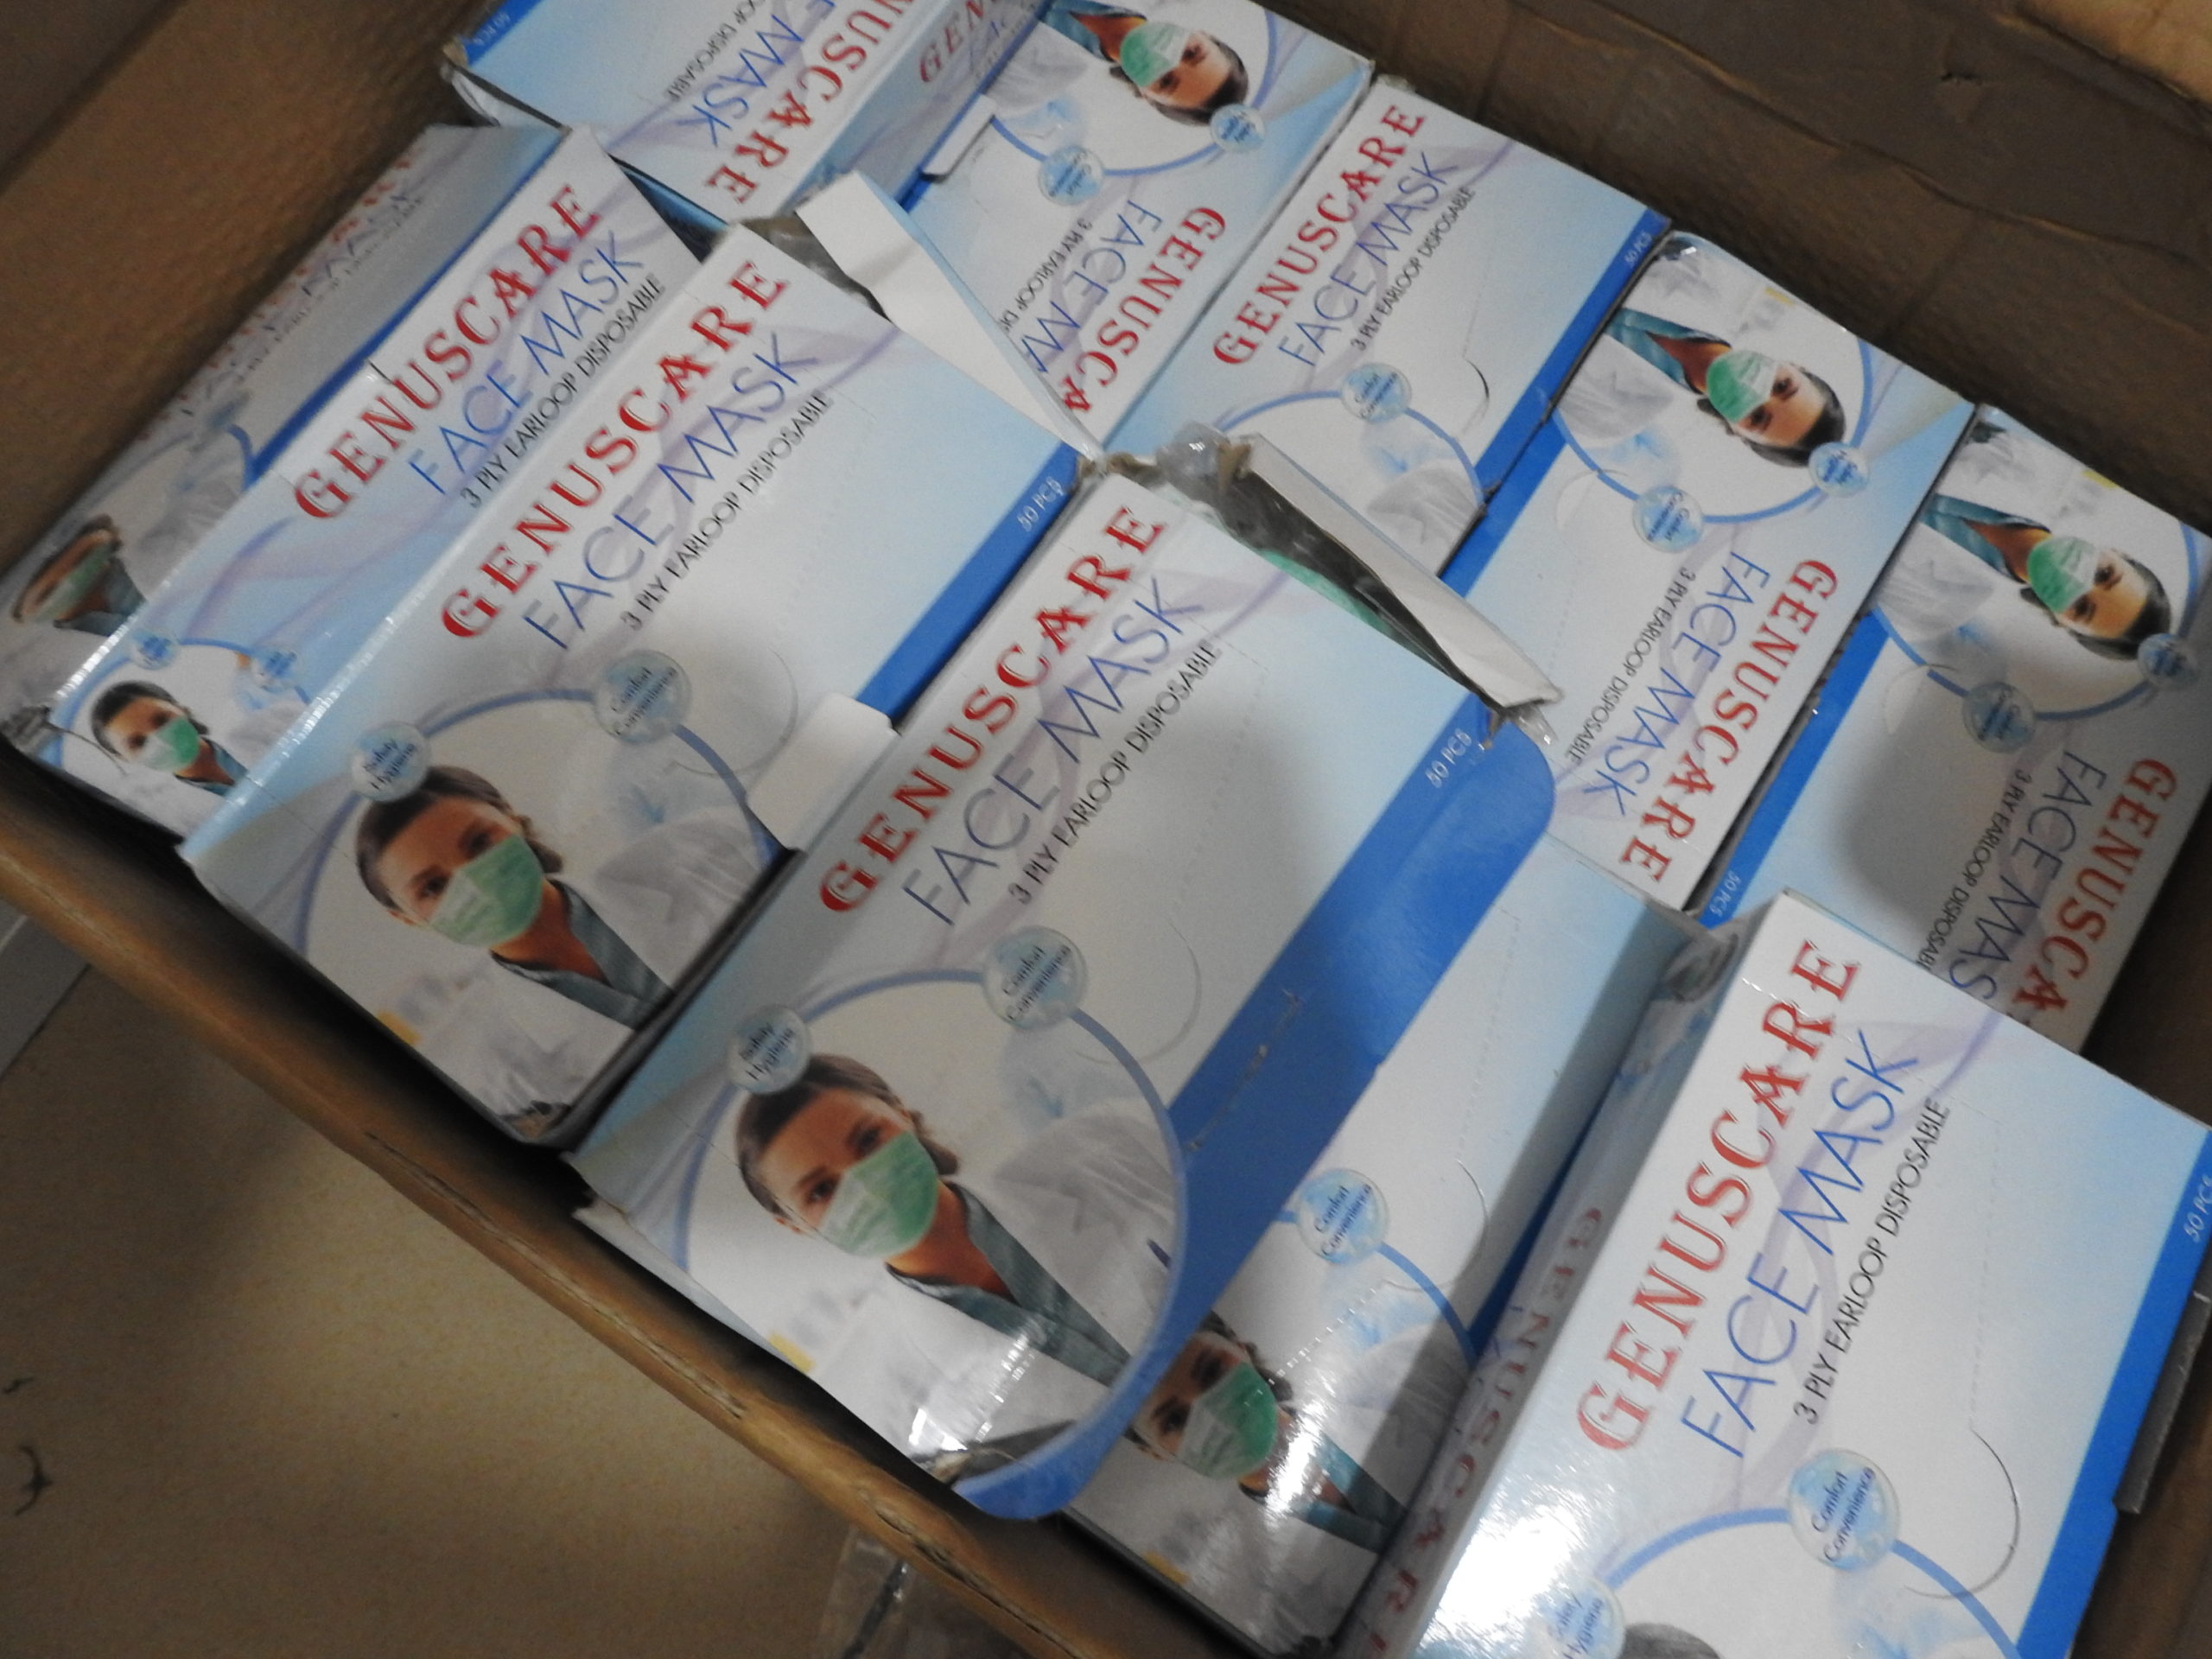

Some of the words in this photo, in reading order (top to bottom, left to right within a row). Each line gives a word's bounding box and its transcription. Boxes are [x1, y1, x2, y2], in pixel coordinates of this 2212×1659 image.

[676, 14, 804, 147] MASK
[707, 0, 916, 204] USCARE
[1014, 249, 1066, 311] EARLOOP
[1062, 229, 1085, 253] PLY
[1064, 200, 1162, 306] FACE
[1077, 216, 1092, 232] 3
[1212, 105, 1426, 365] GENUSCARE
[1278, 263, 1376, 366] FACE
[1356, 152, 1459, 267] MASK
[1351, 337, 1367, 352] 3
[1359, 314, 1383, 340] PLY
[1377, 255, 1424, 317] EARLOOP
[1418, 186, 1477, 258] DISPOSABLE
[294, 184, 601, 518] GENUSCARE
[409, 359, 533, 495] FACE
[519, 231, 644, 375] MASK
[1063, 207, 1227, 413] GENUSCA
[442, 261, 790, 638] GENUSCARE
[461, 487, 481, 508] 3
[475, 454, 508, 491] PLY
[506, 372, 581, 459] EARLOOP
[576, 274, 666, 378] DISPOSABLE
[524, 495, 674, 650] FACE
[657, 333, 819, 503] MASK
[621, 609, 644, 631] 3
[634, 575, 669, 614] PLY
[664, 491, 742, 579] EARLOOP
[736, 390, 835, 495] DISPOSABLE
[1623, 605, 1673, 676] EARLOOP
[1665, 579, 1688, 608] PLY
[1671, 551, 1770, 673] FACE
[1680, 566, 1696, 581] 3
[819, 505, 1166, 912] GENUSCARE
[903, 755, 1060, 925] FACE
[1037, 575, 1203, 763] MASK
[1008, 881, 1033, 905] 3
[1024, 842, 1058, 885] PLY
[1052, 752, 1129, 849] EARLOOP
[1123, 639, 1222, 754] DISPOSABLE
[1567, 675, 1629, 765] DISPOSABLE
[1583, 666, 1695, 816] MASK
[1620, 559, 1838, 882] GENUSCARE
[2014, 769, 2032, 783] 3
[1960, 812, 2013, 888] EARLOOP
[2003, 783, 2025, 815] PLY
[2012, 751, 2108, 880] FACE
[1948, 874, 2040, 1000] MAS
[2012, 759, 2177, 1018] GENUSCA
[1577, 941, 1861, 1451] GENUSCARE
[1875, 1096, 1950, 1237] DISPOSABLE
[1681, 1252, 1819, 1458] FACE
[1778, 1028, 1919, 1255] MASK
[1824, 1236, 1889, 1354] EARLOOP
[1793, 1402, 1818, 1425] 3
[1804, 1350, 1839, 1401] PLY
[1811, 1471, 1849, 1533] Comfort
[1824, 1466, 1876, 1561] Convenience
